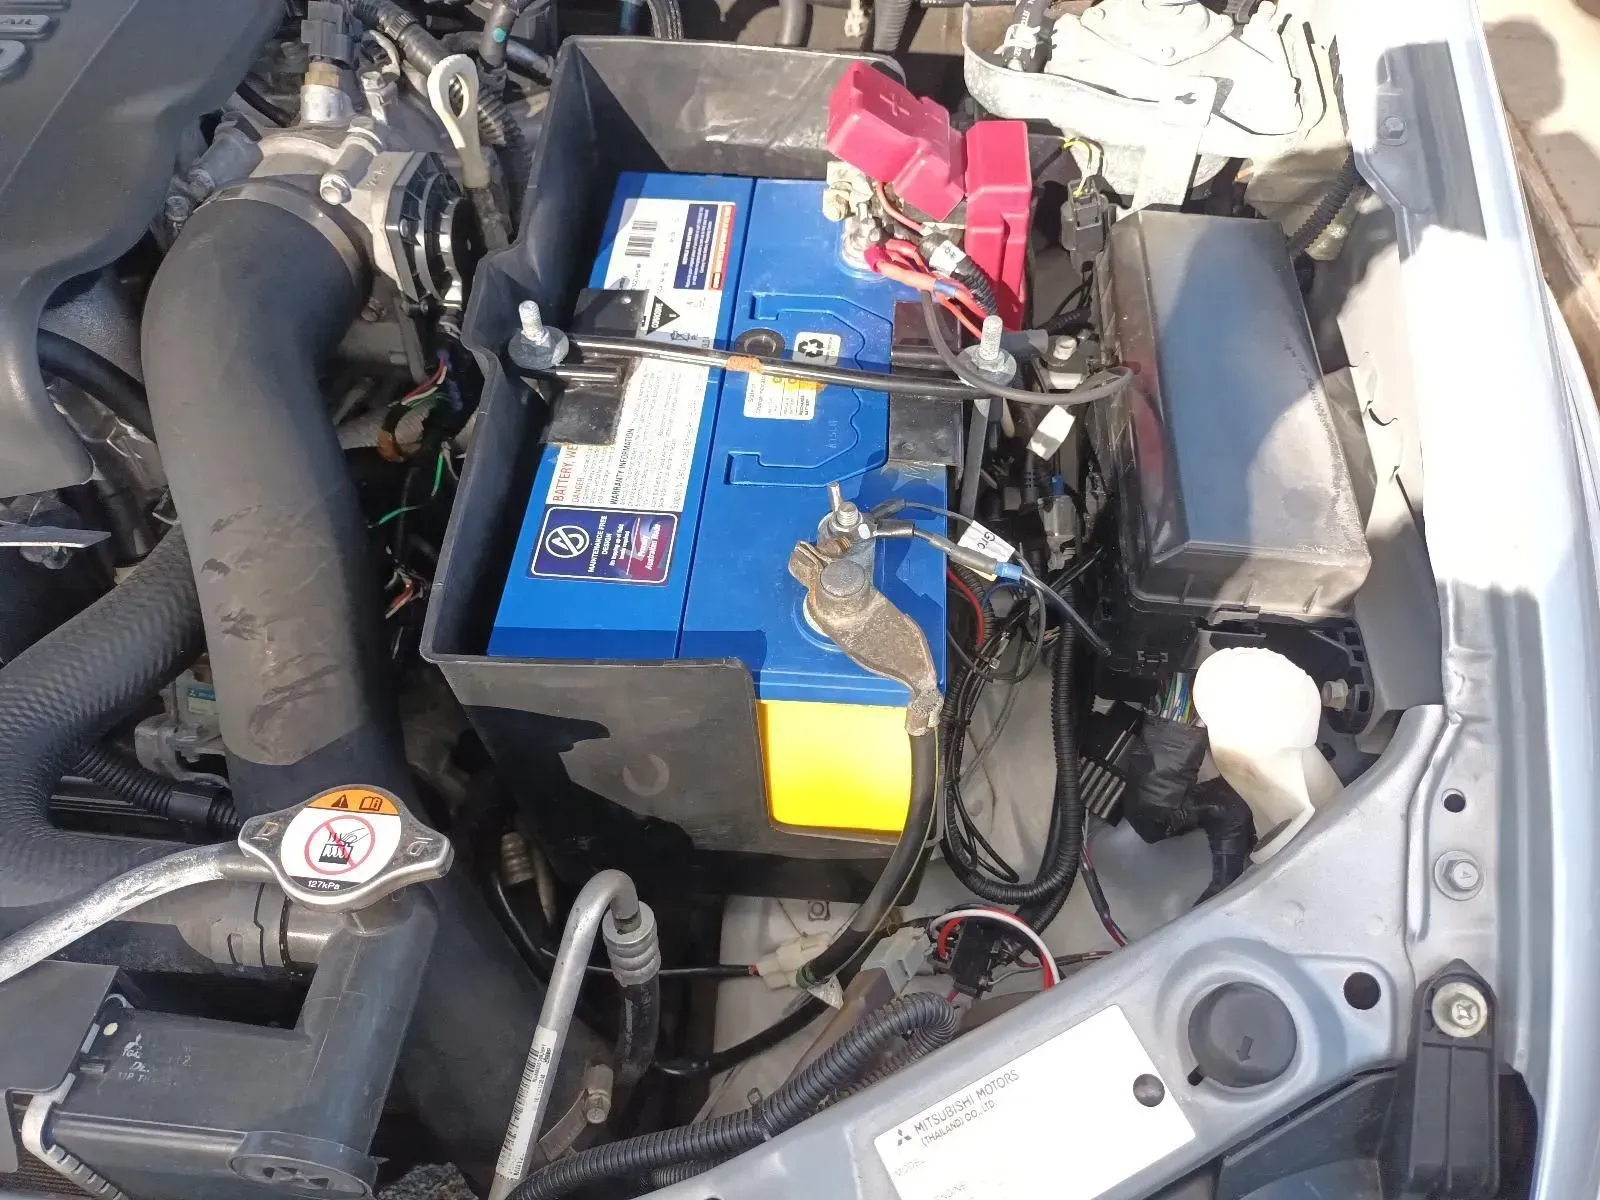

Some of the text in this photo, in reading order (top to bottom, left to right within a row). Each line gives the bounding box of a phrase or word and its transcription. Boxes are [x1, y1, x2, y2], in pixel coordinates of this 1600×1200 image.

[565, 443, 579, 459] WE
[610, 428, 635, 504] WARRANTY INFORMATION
[587, 515, 608, 572] MAINTENANCE FREE
[601, 533, 612, 554] DESIGN
[308, 880, 340, 890] 127kPa
[914, 1069, 1020, 1135] MITSUBISHI MOTORS
[921, 1116, 965, 1147] (THAILAND)
